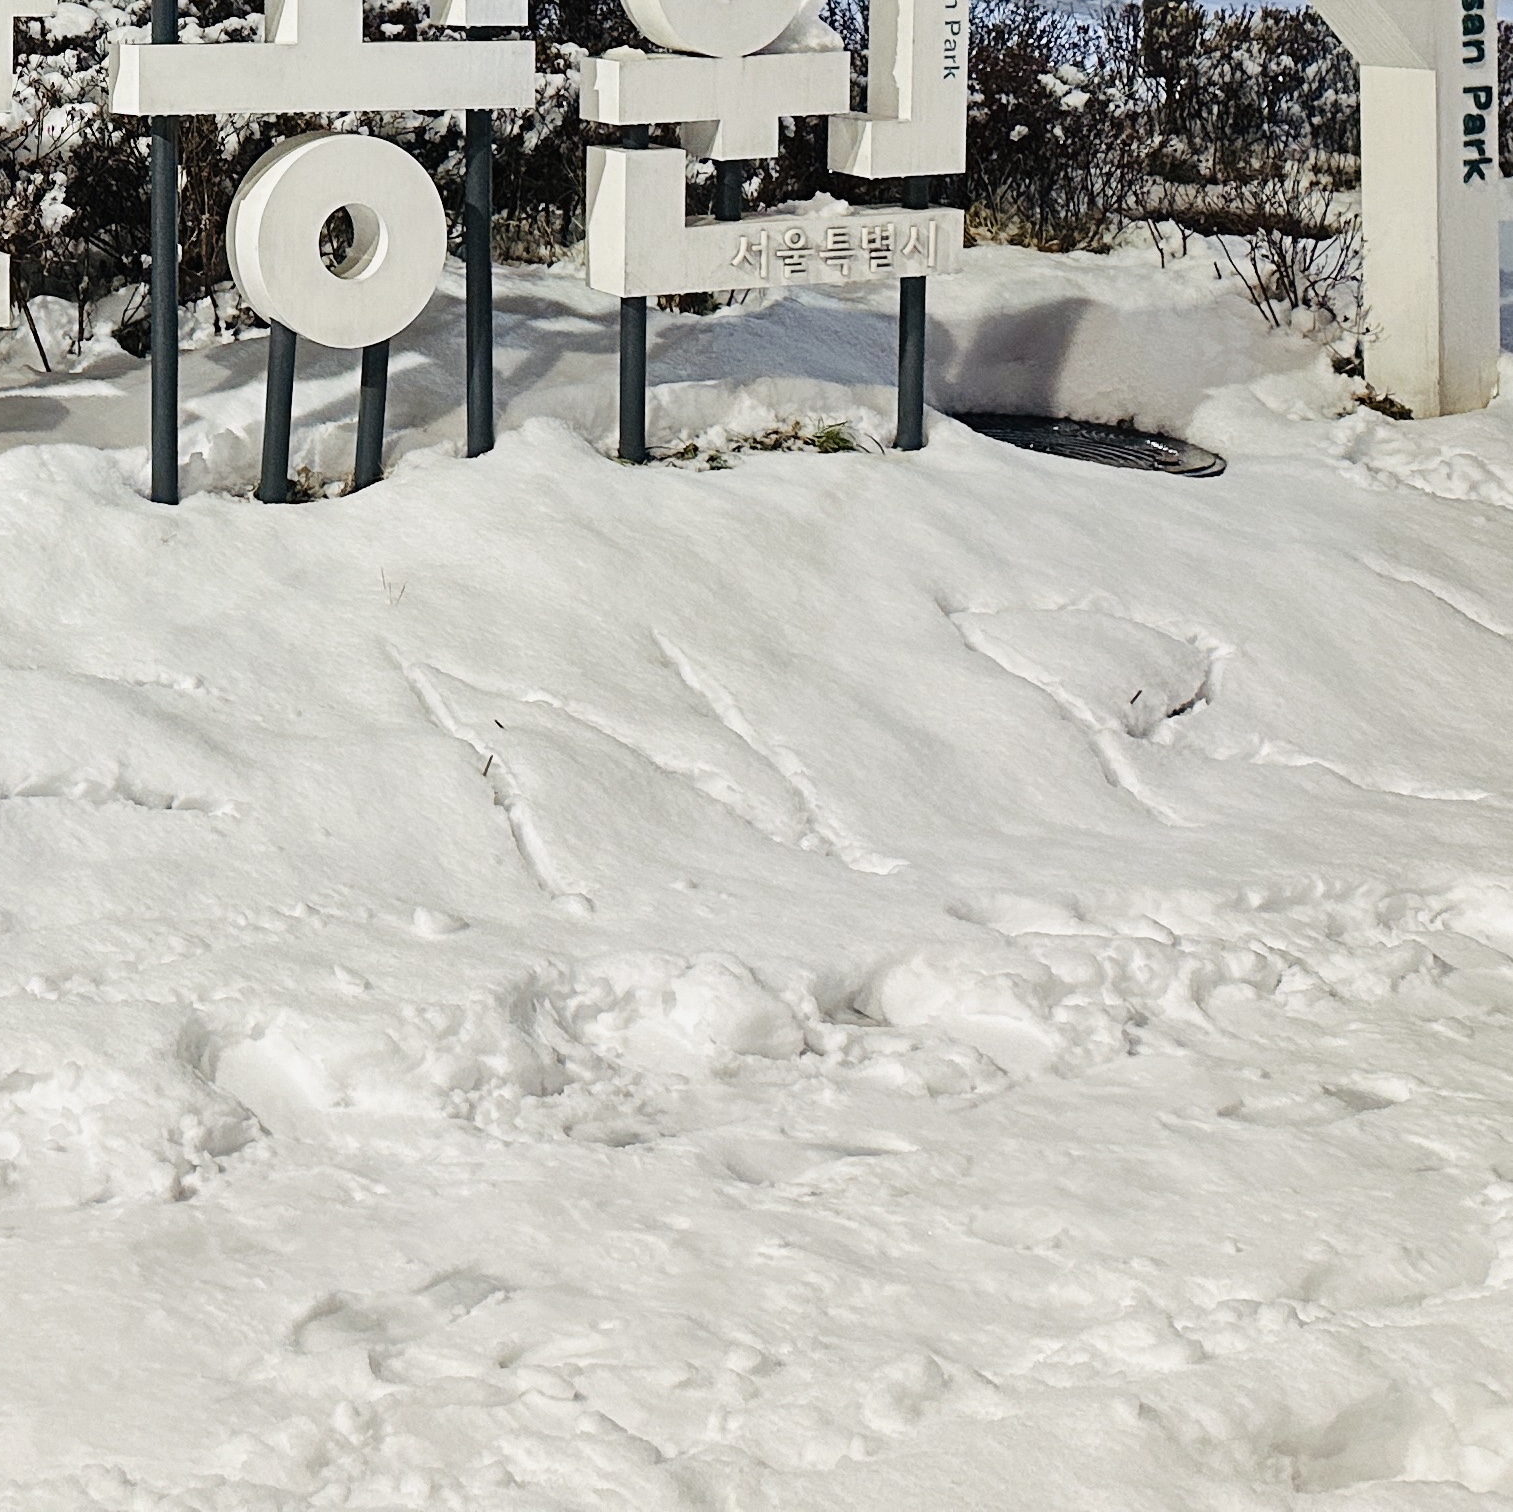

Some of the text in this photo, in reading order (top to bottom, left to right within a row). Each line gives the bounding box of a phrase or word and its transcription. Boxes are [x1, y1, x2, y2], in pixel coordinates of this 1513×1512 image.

[943, 20, 961, 80] Park
[1462, 85, 1493, 184] Park
[730, 219, 938, 279] 서울특별시
